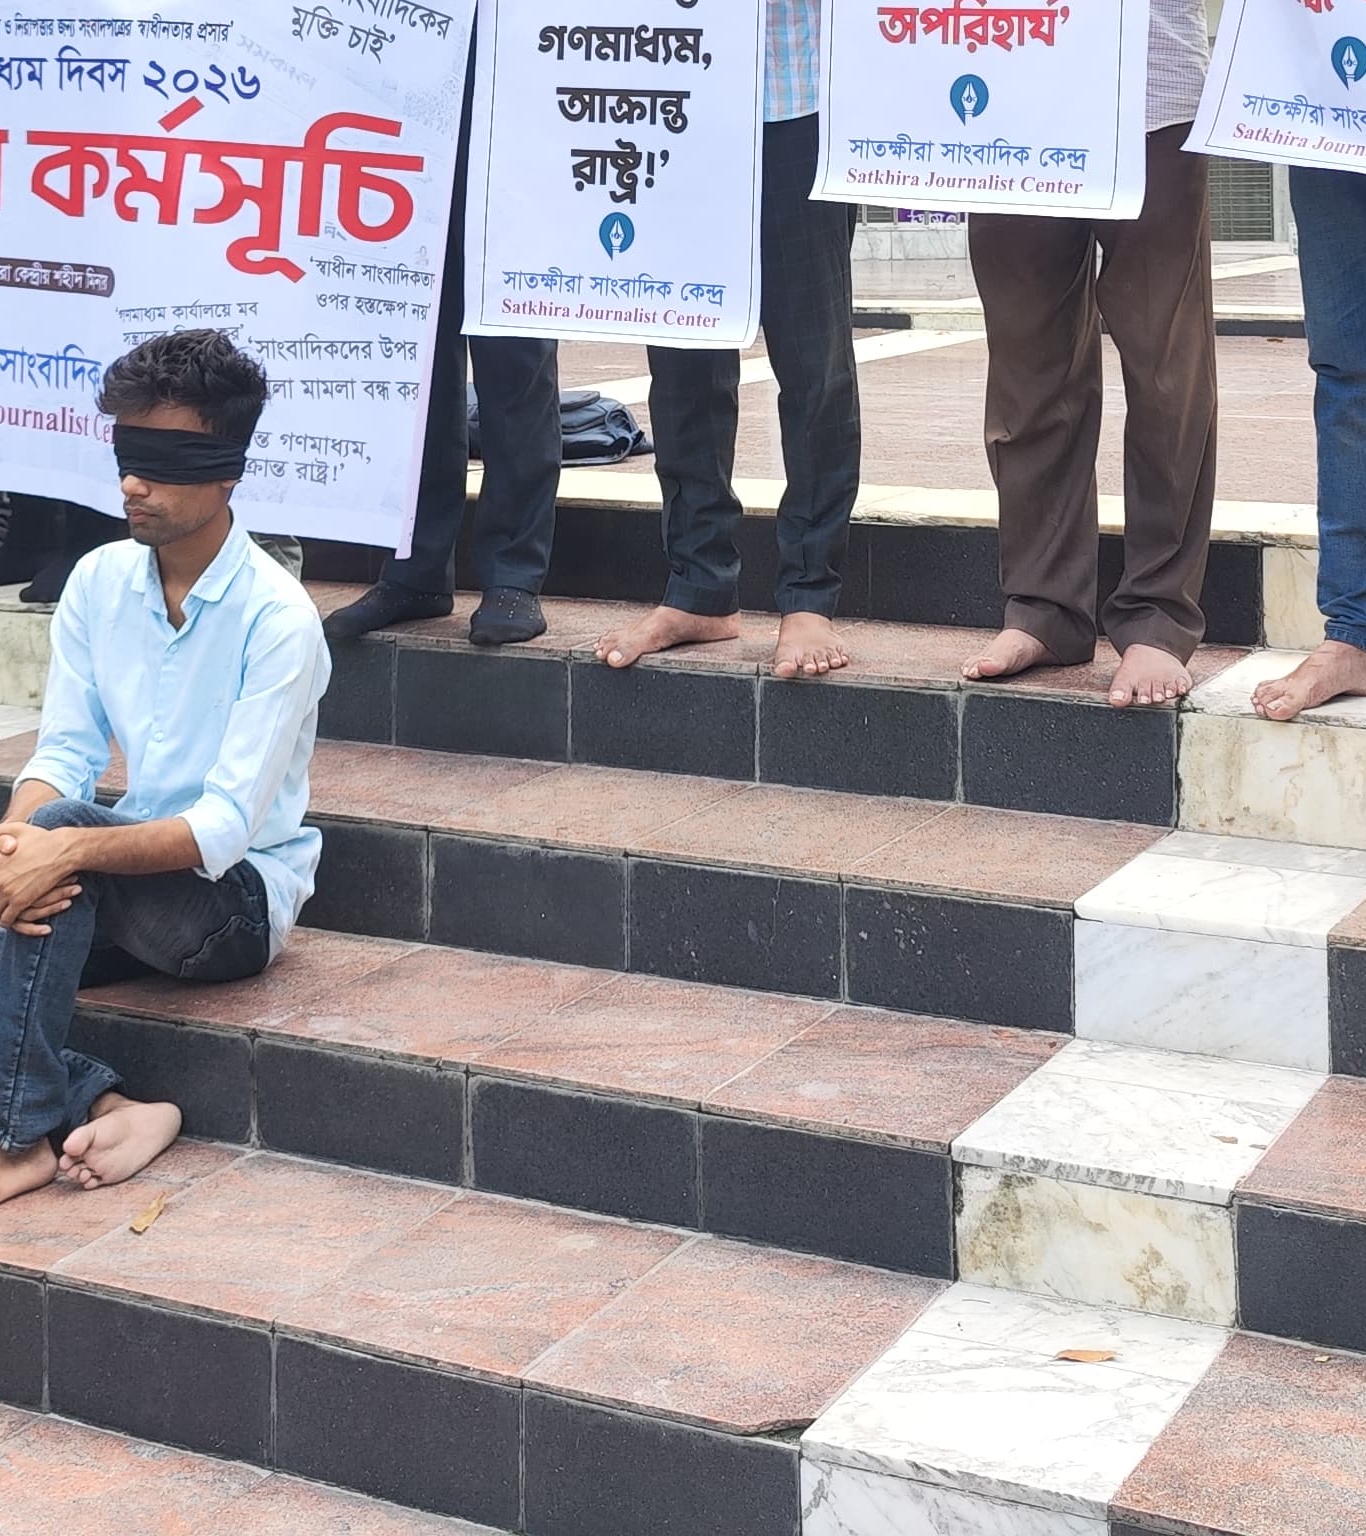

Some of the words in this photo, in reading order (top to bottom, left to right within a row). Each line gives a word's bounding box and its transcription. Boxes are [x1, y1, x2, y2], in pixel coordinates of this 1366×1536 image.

[138, 13, 194, 41] স্বাধীনতার
[196, 20, 234, 43] প্রসার’
[292, 6, 344, 42] মুক্তি
[348, 24, 395, 64] চাই’
[538, 24, 712, 70] গণমাধ্যম,
[54, 45, 131, 92] দিবস
[143, 60, 261, 104] ২০২৬
[556, 87, 690, 135] আক্রান্ত
[1243, 93, 1324, 128] সাতক্ষীরা
[1232, 122, 1309, 149] Satkhira
[848, 134, 934, 164] সাতক্ষীরা
[941, 138, 1032, 168] সাংবাদিক
[1039, 147, 1089, 173] কেন্দ্র
[571, 139, 669, 204] রাষ্ট্র!’
[846, 168, 919, 187] Satkhira
[925, 172, 1014, 192] Journalist
[1020, 176, 1083, 195] Center
[26, 95, 424, 283] কর্মসূচি
[53, 266, 83, 289] শহীদ
[310, 256, 356, 280] ‘স্বাধীন
[503, 267, 582, 295] সাতক্ষীরা
[590, 274, 674, 300] সাংবাদিক
[680, 283, 726, 307] কেন্দ্র
[171, 299, 232, 320] কার্যালয়ে
[236, 302, 259, 316] মব
[316, 293, 349, 311] ওপর
[354, 296, 407, 318] হস্তক্ষেপ
[502, 298, 571, 318] Satkhira
[575, 303, 658, 324] Journalist
[663, 309, 720, 328] Center
[248, 333, 373, 361] ‘সাংবাদিকদের
[378, 336, 418, 361] উপর
[300, 379, 356, 400] মামলা
[362, 380, 391, 400] বন্ধ
[395, 381, 420, 400] কর
[280, 432, 372, 464] গণমাধ্যম,
[245, 458, 289, 478] ক্রান্ত
[295, 461, 345, 485] রাষ্ট্র!’
